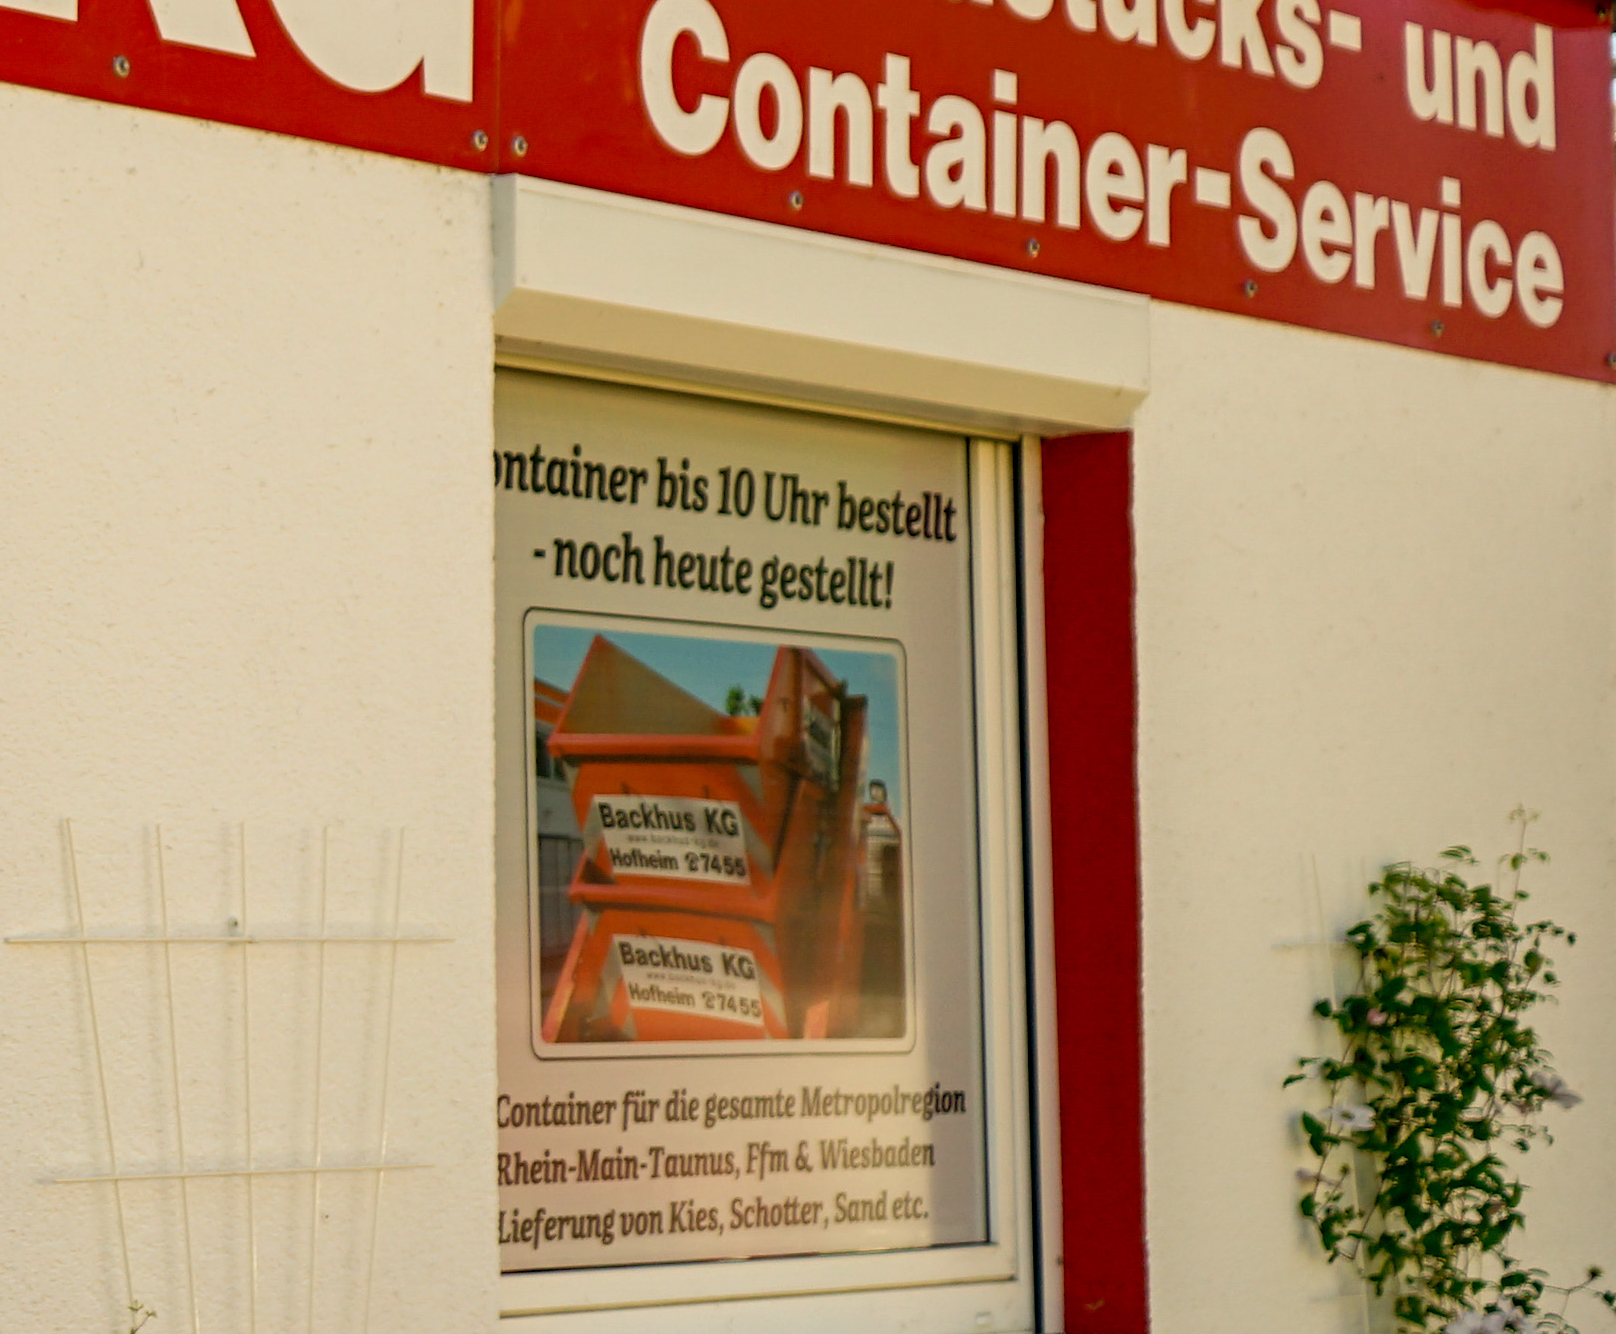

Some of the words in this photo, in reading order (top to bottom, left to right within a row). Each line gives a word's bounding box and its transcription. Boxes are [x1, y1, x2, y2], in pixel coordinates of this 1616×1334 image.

[1405, 21, 1557, 150] und
[657, 457, 709, 513] bis
[718, 466, 755, 518] 10
[764, 470, 829, 527] Uhr
[837, 481, 958, 543] bestellt
[654, 535, 752, 595] heute
[760, 554, 895, 609] gestellt!
[598, 802, 696, 832] Backhus
[704, 807, 739, 836] KG
[609, 847, 679, 870] Hofheim
[618, 940, 713, 973] Backhus
[721, 951, 755, 980] KG
[628, 981, 696, 1007] Hofheim
[496, 1090, 617, 1128] Container
[622, 1090, 660, 1131] für
[666, 1088, 699, 1123] die
[704, 1087, 796, 1128] gesamte
[800, 1082, 967, 1124] Metropolregion
[497, 1144, 741, 1186] Rhein-Main-Taunus,
[745, 1140, 789, 1181] Ffm
[795, 1142, 813, 1173] &
[819, 1136, 936, 1170] Wiesbaden
[498, 1207, 615, 1250] Lieferung
[621, 1208, 664, 1236] von
[667, 1200, 724, 1236] Kies,
[729, 1194, 830, 1231] Schotter,
[834, 1190, 888, 1223] Sand
[892, 1194, 930, 1223] etc.
